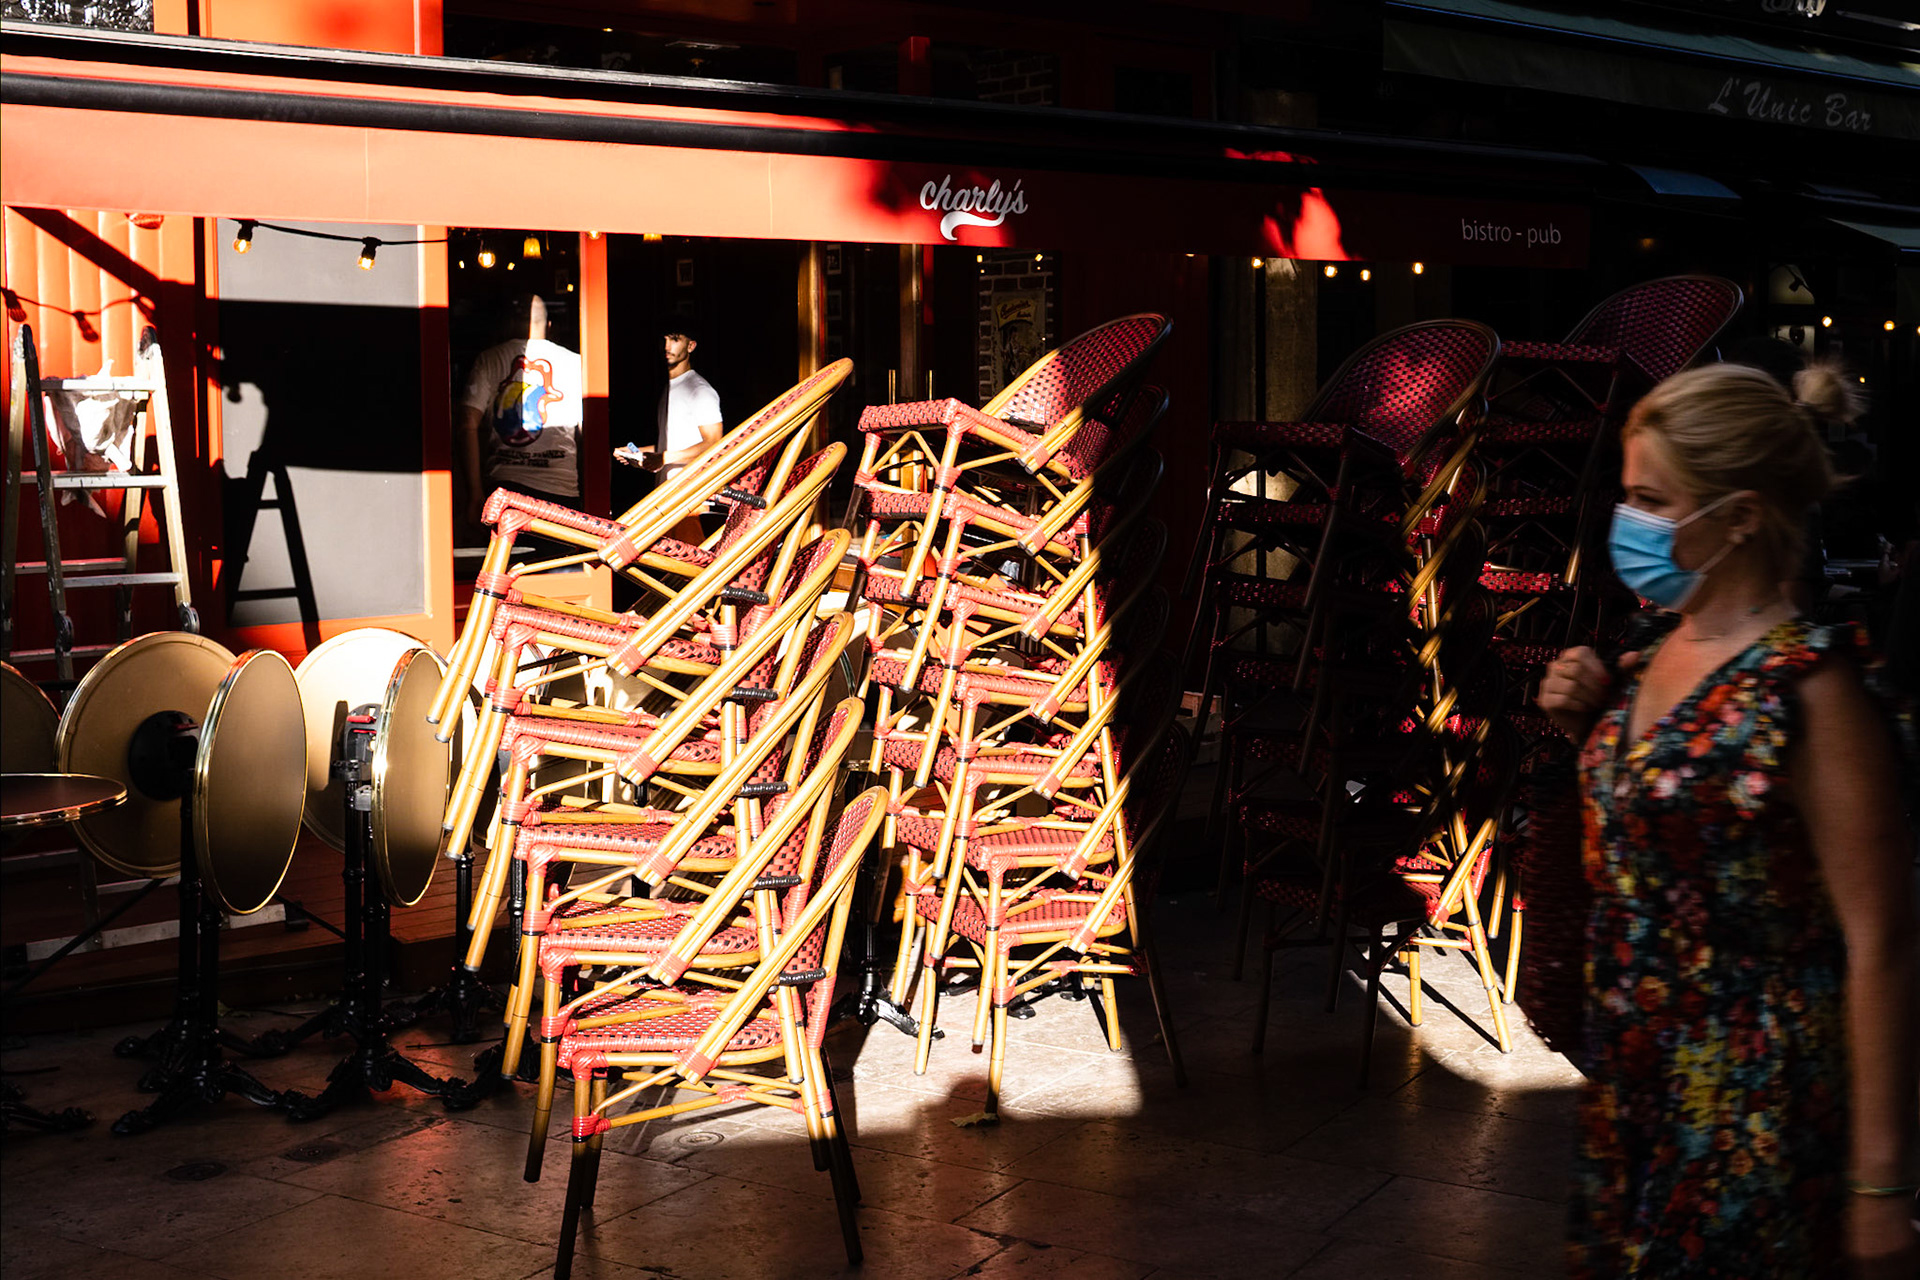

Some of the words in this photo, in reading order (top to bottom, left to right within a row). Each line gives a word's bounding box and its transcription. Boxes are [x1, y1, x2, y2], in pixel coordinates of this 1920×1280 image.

[1824, 92, 1873, 131] Bar
[1461, 218, 1512, 242] bistro
[1527, 222, 1561, 248] pub
